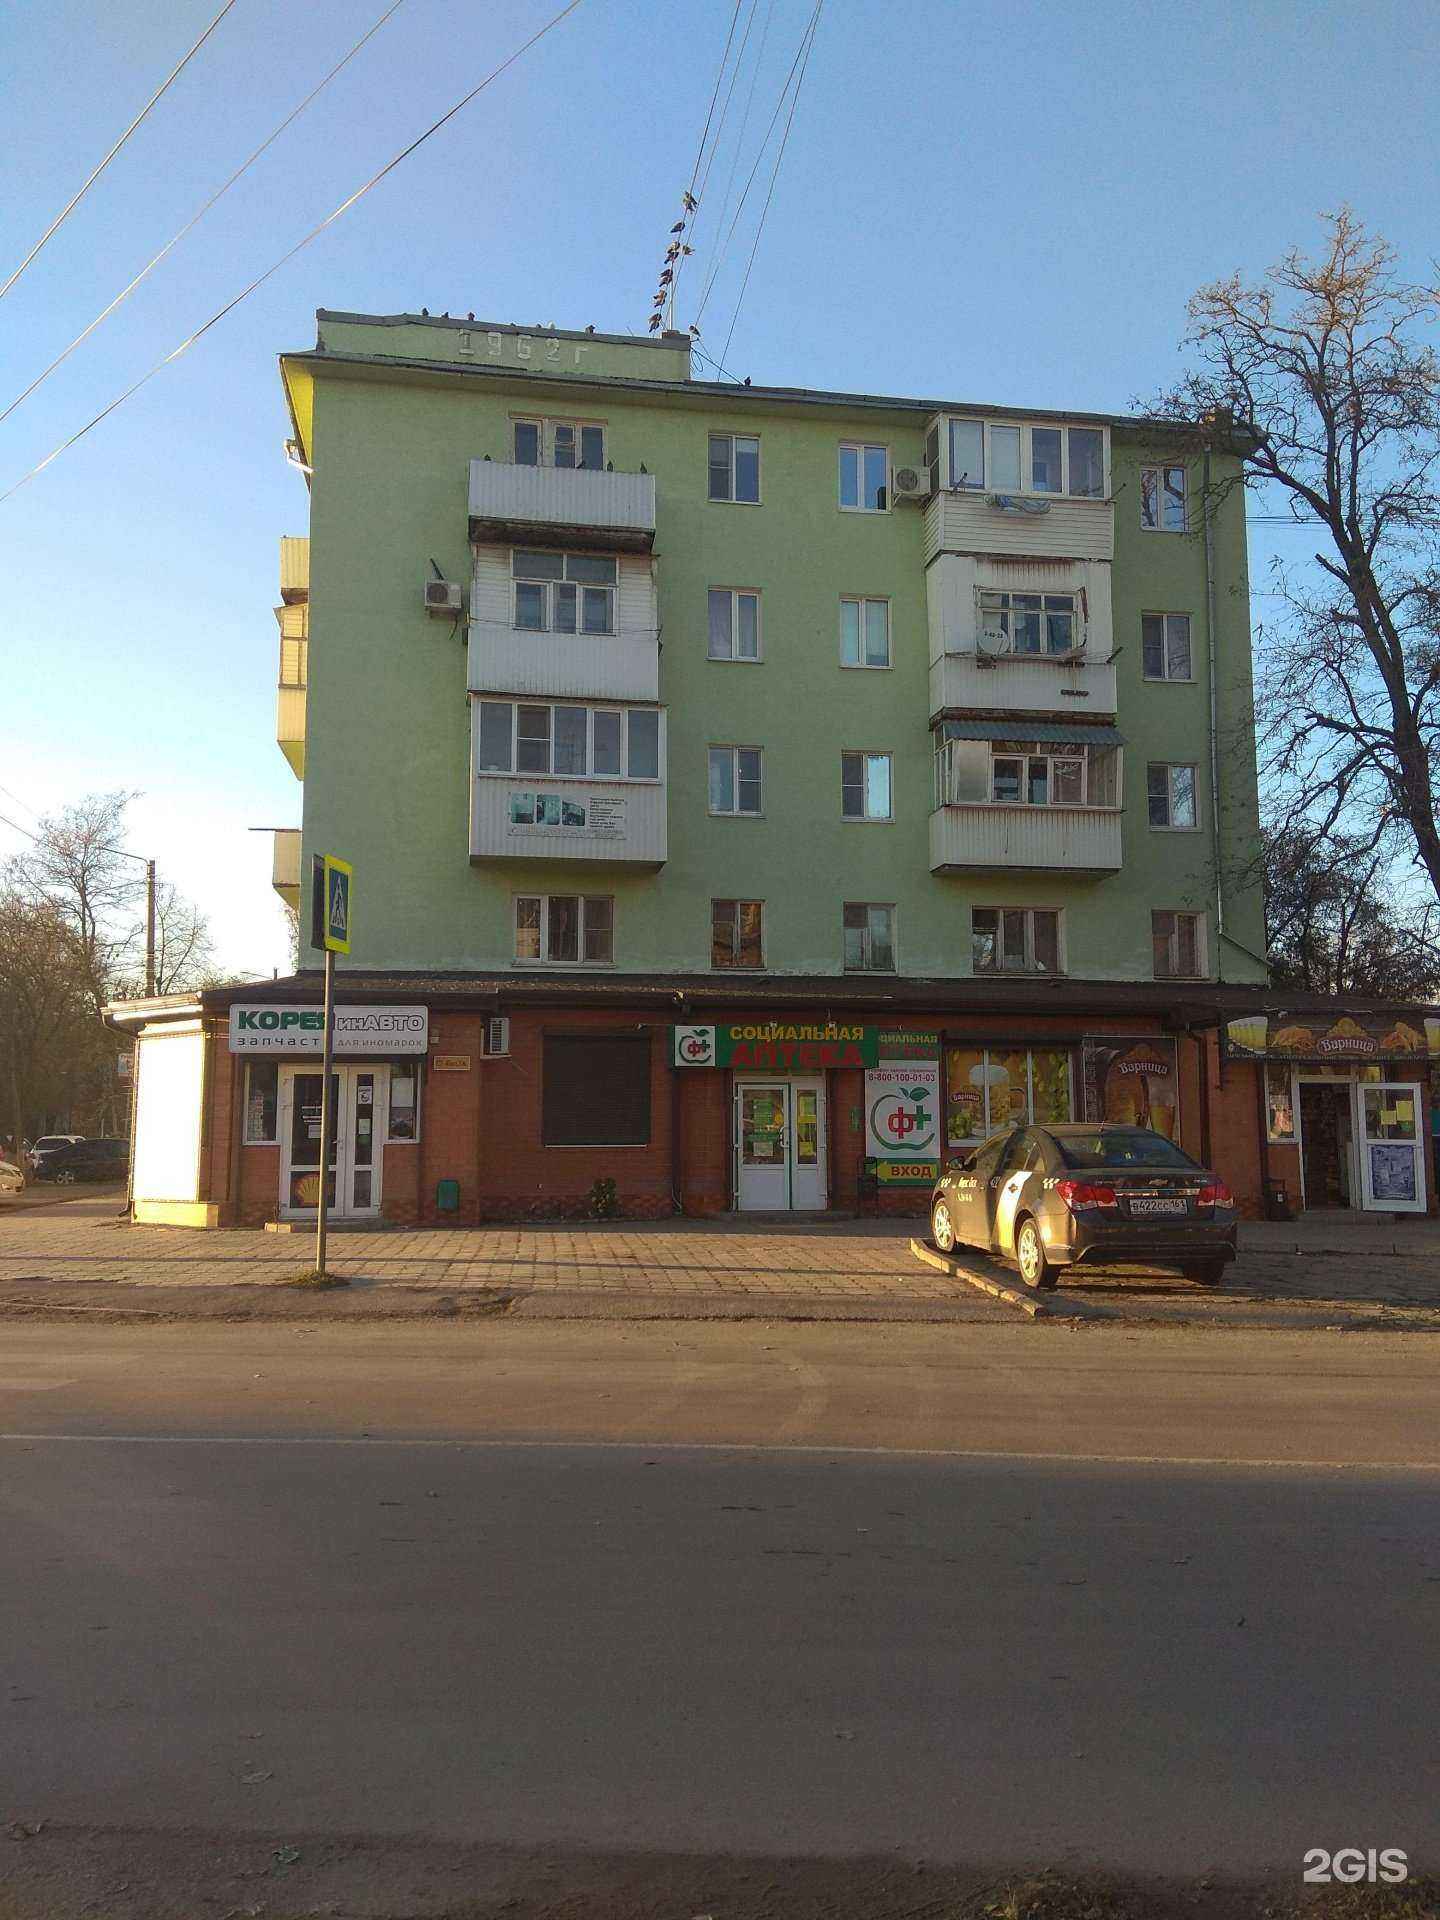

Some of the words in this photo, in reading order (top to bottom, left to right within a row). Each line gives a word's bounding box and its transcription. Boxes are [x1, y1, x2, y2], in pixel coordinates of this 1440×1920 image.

[729, 1026, 865, 1042] СОЦИАЛЬНАЯ
[237, 1037, 321, 1047] запчаст
[337, 1039, 358, 1048] для
[362, 1038, 422, 1049] иномарок
[1320, 1038, 1375, 1052] Варница
[730, 1042, 865, 1067] АПТЕКА
[1118, 1061, 1169, 1075] Варница
[890, 1165, 932, 1178] ВХОД
